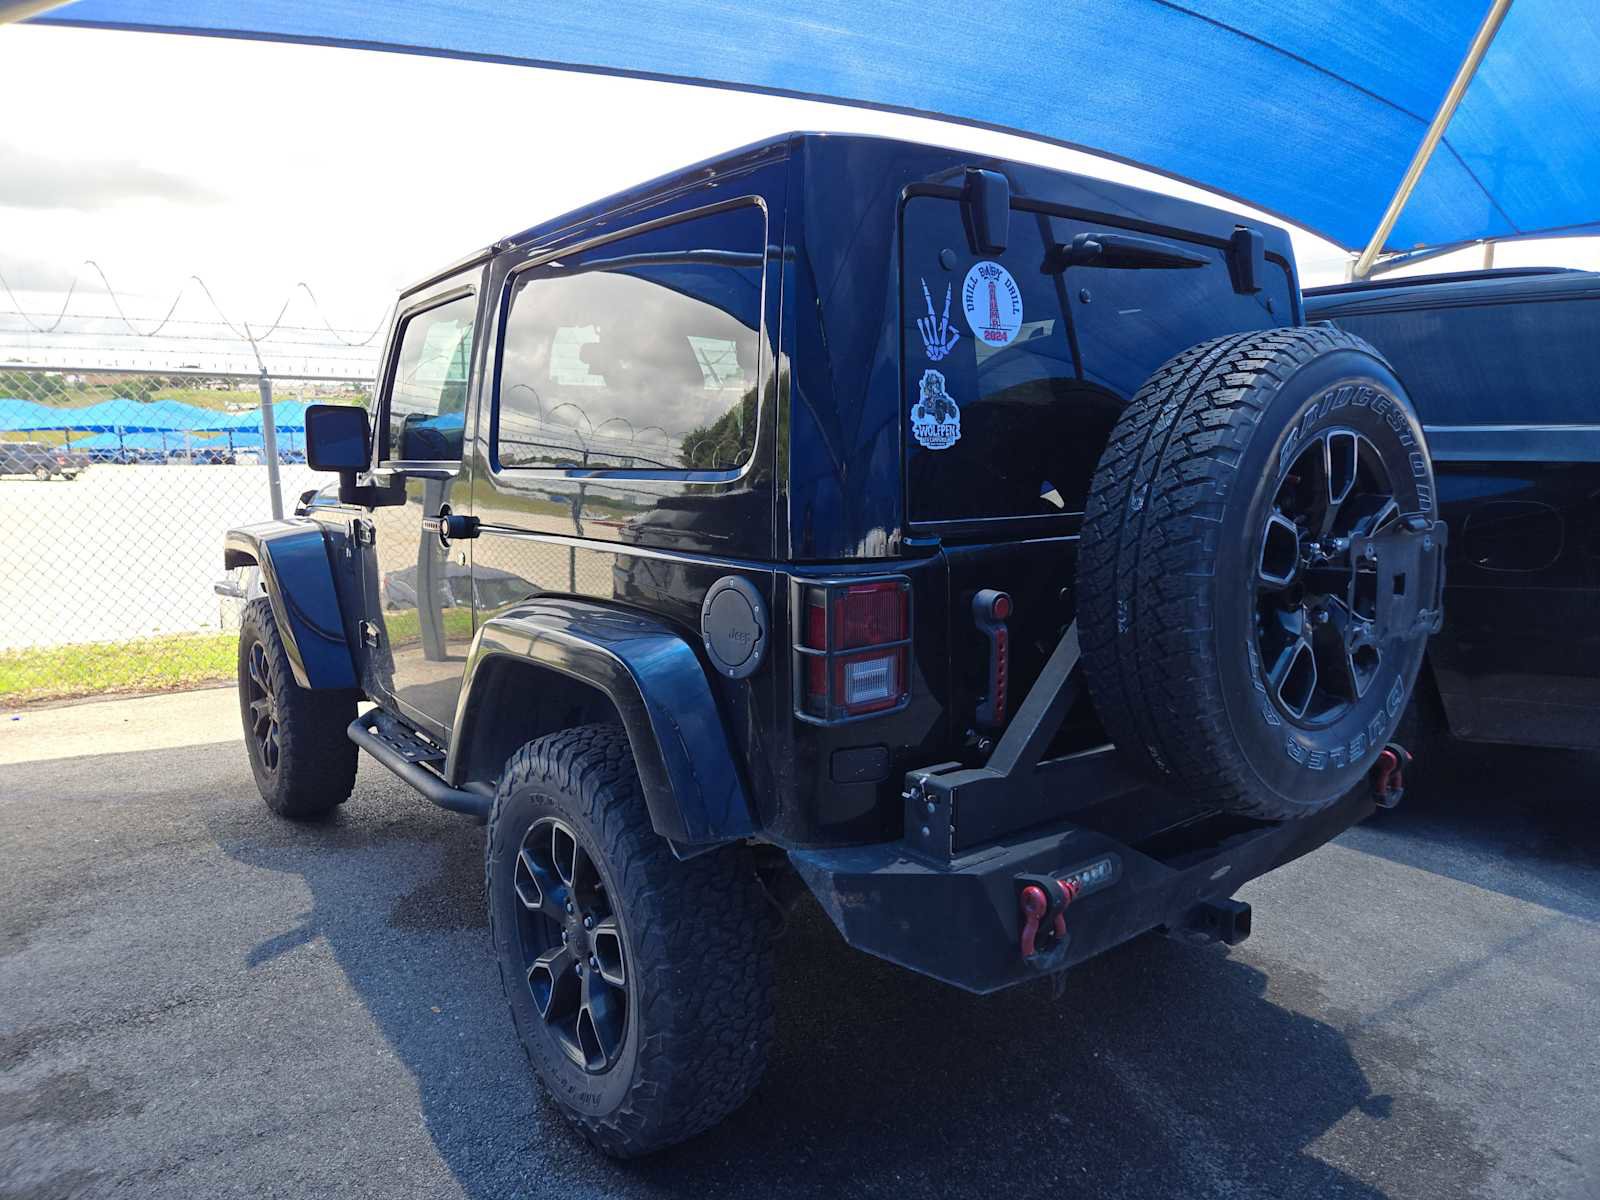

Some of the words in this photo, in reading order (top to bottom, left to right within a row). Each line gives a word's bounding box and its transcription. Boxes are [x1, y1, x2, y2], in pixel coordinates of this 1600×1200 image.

[966, 276, 978, 312] DRILL
[978, 264, 1003, 279] BABY
[1004, 278, 1020, 315] DRILL
[983, 330, 1008, 342] 2024
[919, 423, 957, 437] WOLFPEN
[1278, 385, 1433, 513] BRIDGESTON
[728, 627, 752, 645] Jeep
[1286, 674, 1405, 772] DUELER
